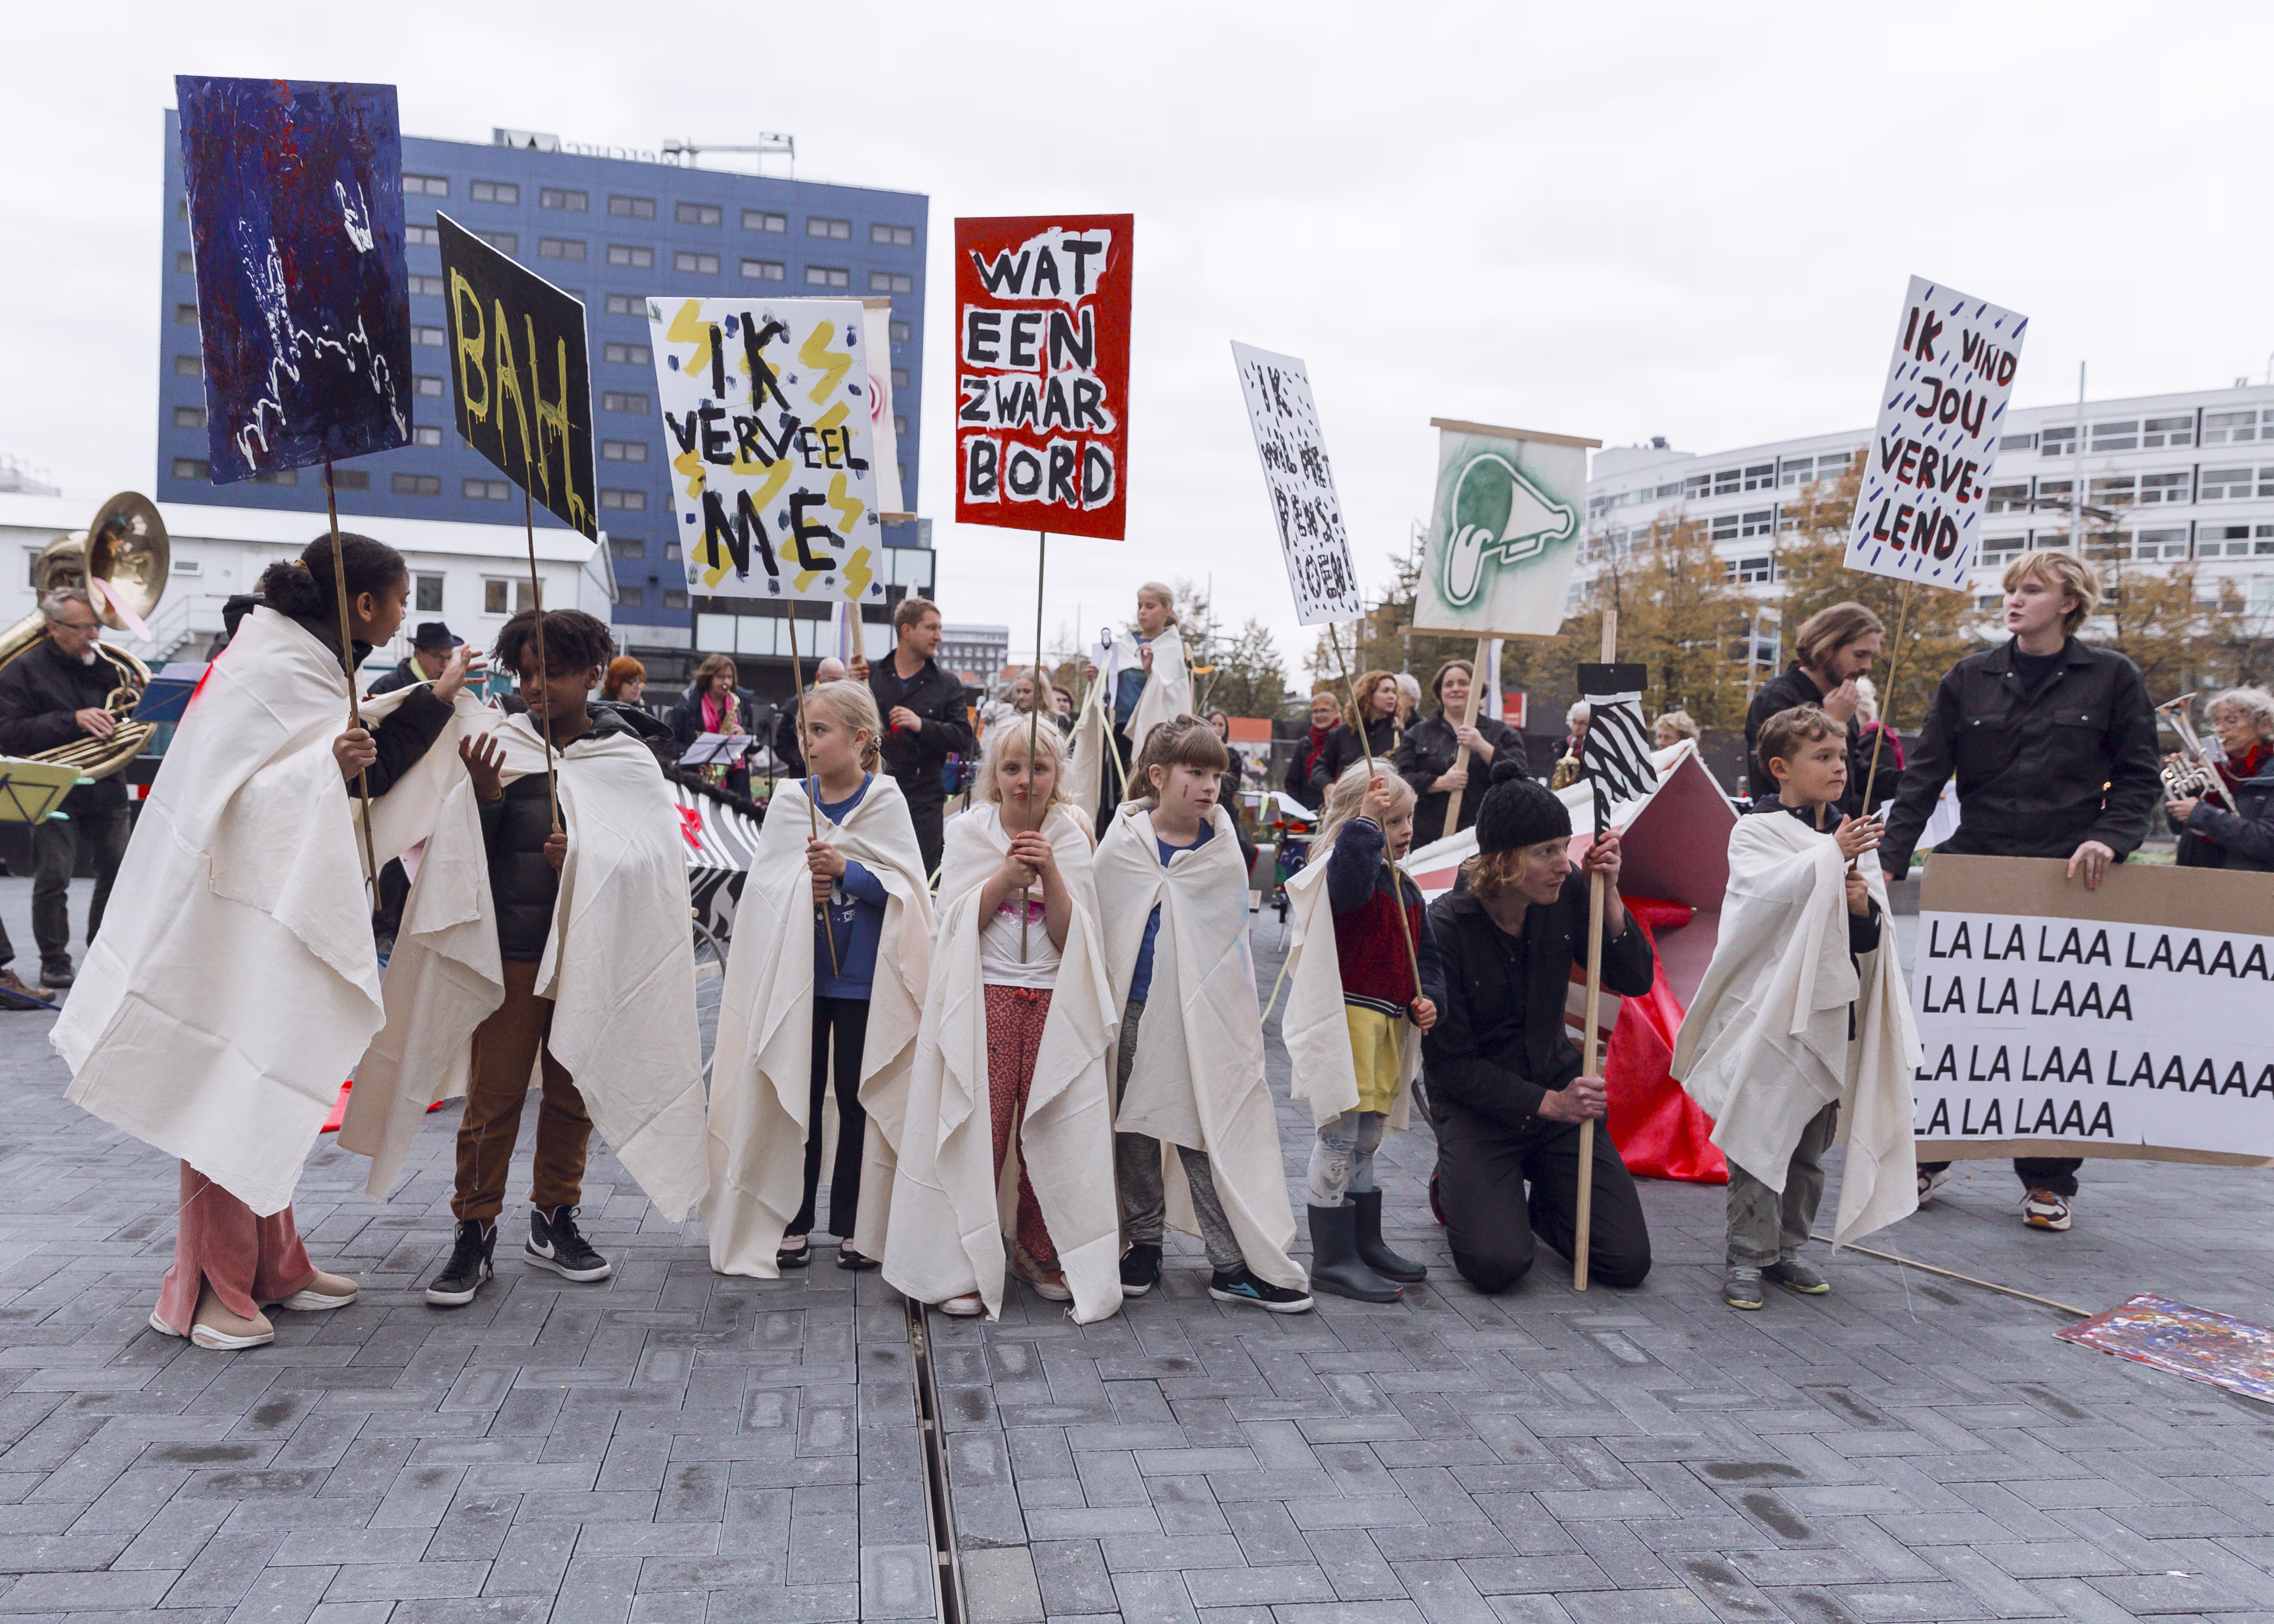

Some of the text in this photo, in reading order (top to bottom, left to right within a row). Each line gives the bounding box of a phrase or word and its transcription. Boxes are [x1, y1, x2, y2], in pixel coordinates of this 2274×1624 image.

[972, 239, 1102, 296] WAT
[710, 312, 791, 412] IK
[968, 310, 1092, 369] EEN
[1903, 307, 2017, 386] IK VIND
[451, 266, 596, 536] BAH
[960, 376, 1106, 428] ZWAAR
[1257, 365, 1293, 418] IK
[1916, 376, 1987, 438] JOU
[665, 408, 869, 471] VERVEEL
[1881, 435, 1983, 503] VERVE-
[969, 440, 1112, 505] BORD
[703, 489, 836, 576] ME
[1873, 498, 1958, 560] LEND
[1929, 920, 2274, 981] LA LA LAA LAAAA
[1922, 975, 2133, 1021] LA LA LAAA
[1915, 1043, 1957, 1081] LA
[1969, 1044, 2010, 1082] LA
[2022, 1045, 2093, 1084] LAA
[1961, 1098, 2003, 1135] LA
[2014, 1098, 2114, 1138] LAAA
